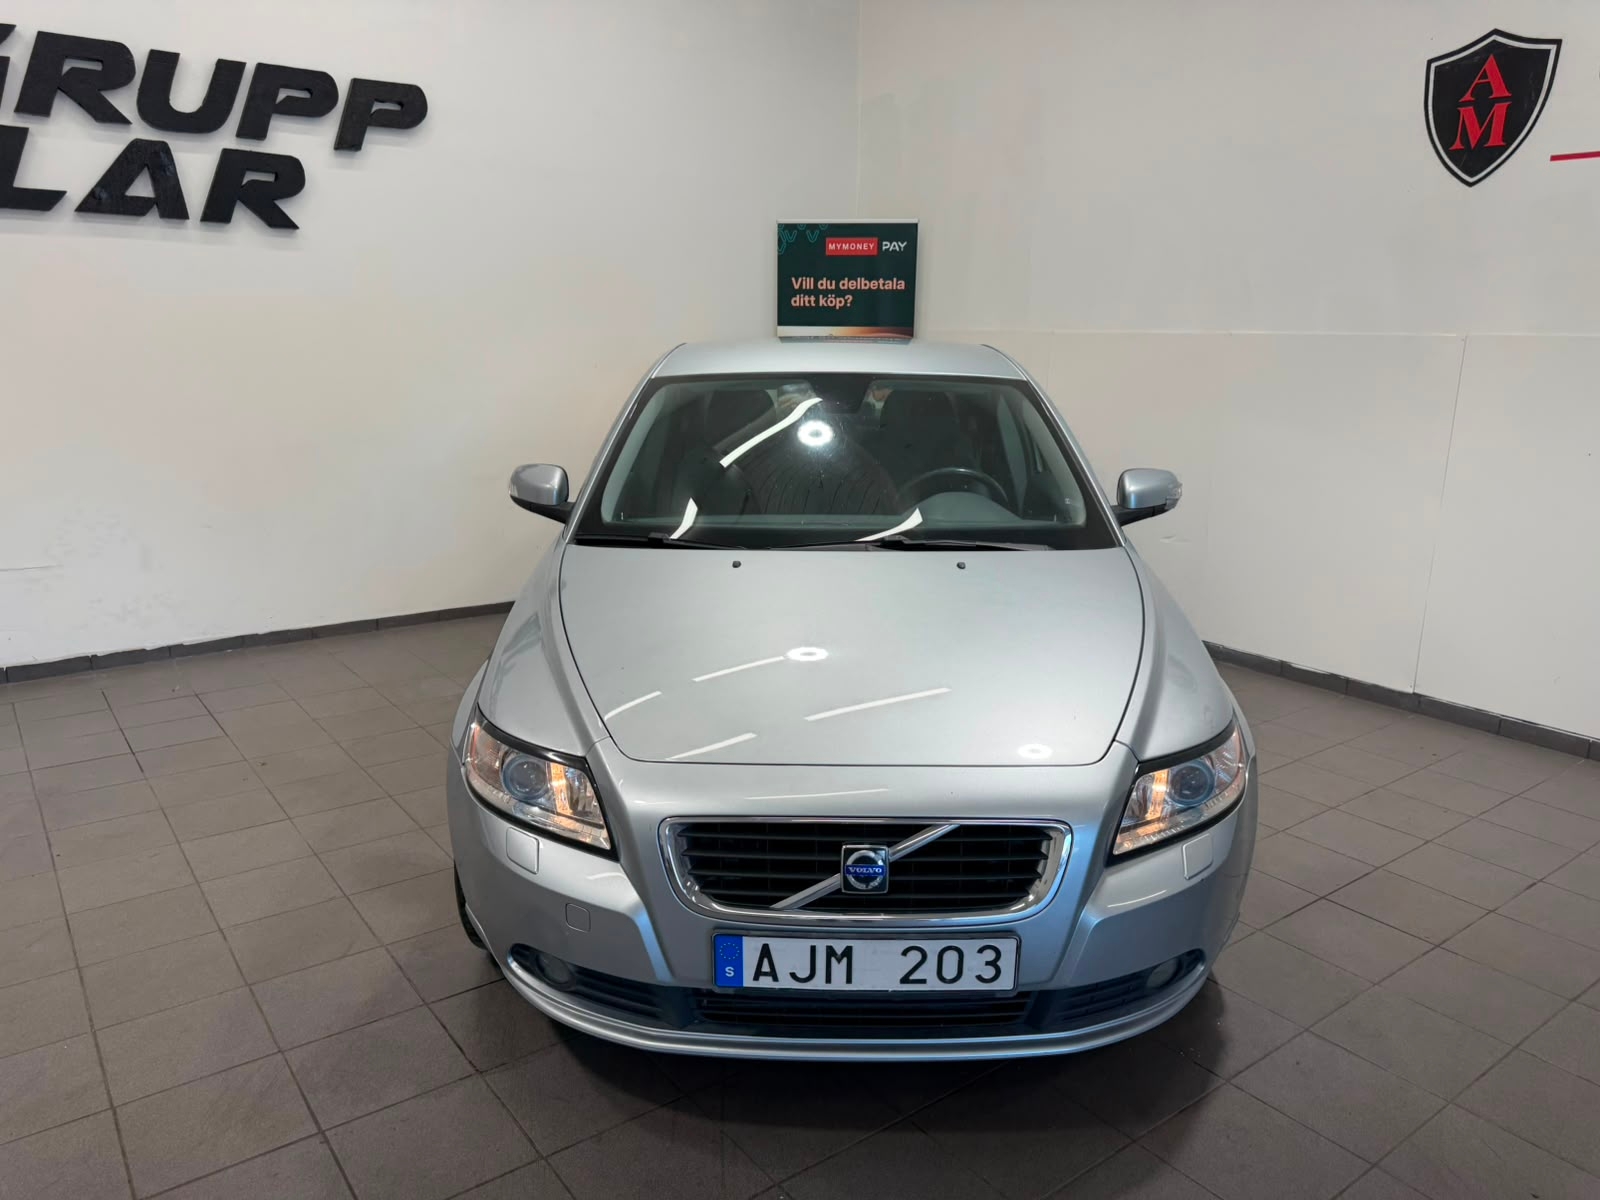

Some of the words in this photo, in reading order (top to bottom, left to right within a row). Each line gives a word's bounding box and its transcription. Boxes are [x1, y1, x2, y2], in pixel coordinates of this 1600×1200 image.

[882, 241, 907, 251] PAY
[791, 277, 814, 290] Vill
[817, 277, 835, 290] du
[839, 277, 905, 290] delbetala
[791, 295, 816, 307] ditt
[819, 295, 853, 309] köp?
[752, 943, 854, 985] AJM
[899, 944, 1002, 985] 203
[725, 966, 735, 977] S
